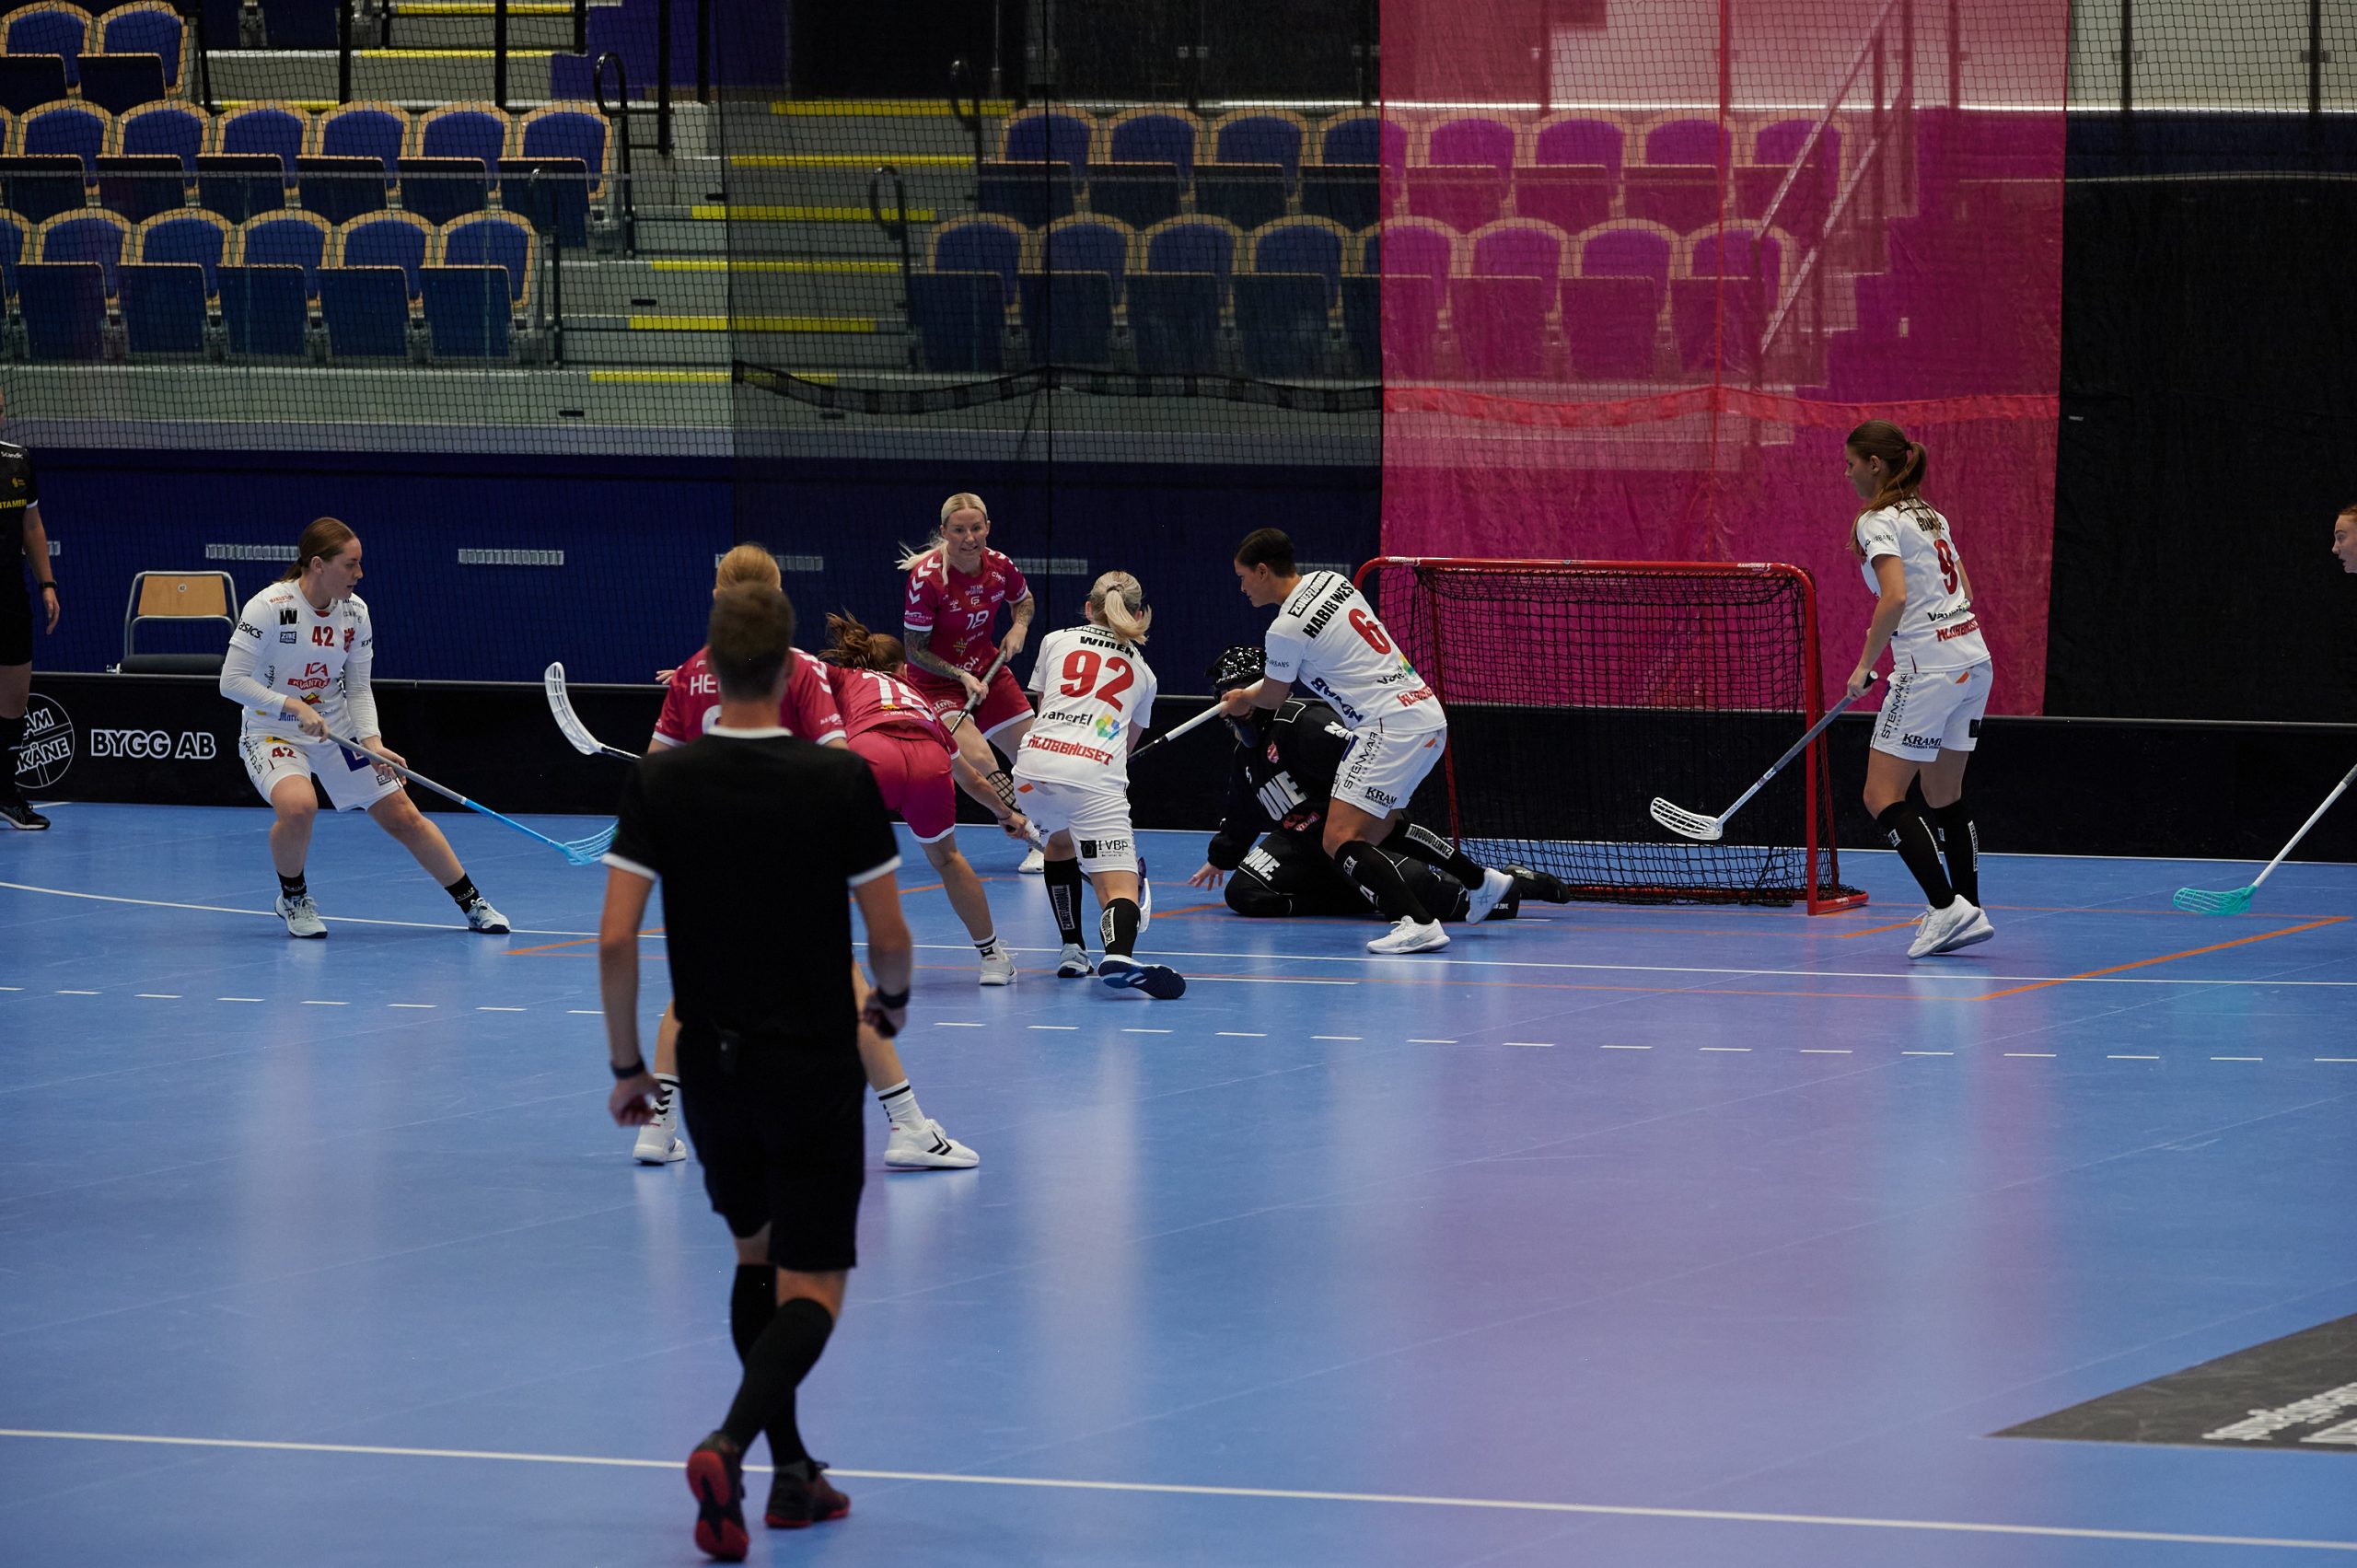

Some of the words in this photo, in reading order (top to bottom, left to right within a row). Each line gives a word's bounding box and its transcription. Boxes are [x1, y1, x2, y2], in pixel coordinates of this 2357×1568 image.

[1934, 539, 1957, 595] 9
[966, 610, 989, 630] 18
[1303, 600, 1340, 639] HABIB
[1329, 580, 1354, 604] WES
[311, 625, 334, 646] 42
[1349, 608, 1391, 655] 6
[305, 662, 329, 678] ICA
[690, 673, 721, 696] HE
[1060, 649, 1134, 714] 92
[91, 729, 171, 759] BYGG
[175, 732, 216, 760] AB
[272, 747, 296, 759] 42
[1257, 771, 1308, 821] ONE
[1243, 845, 1281, 881] ONE.
